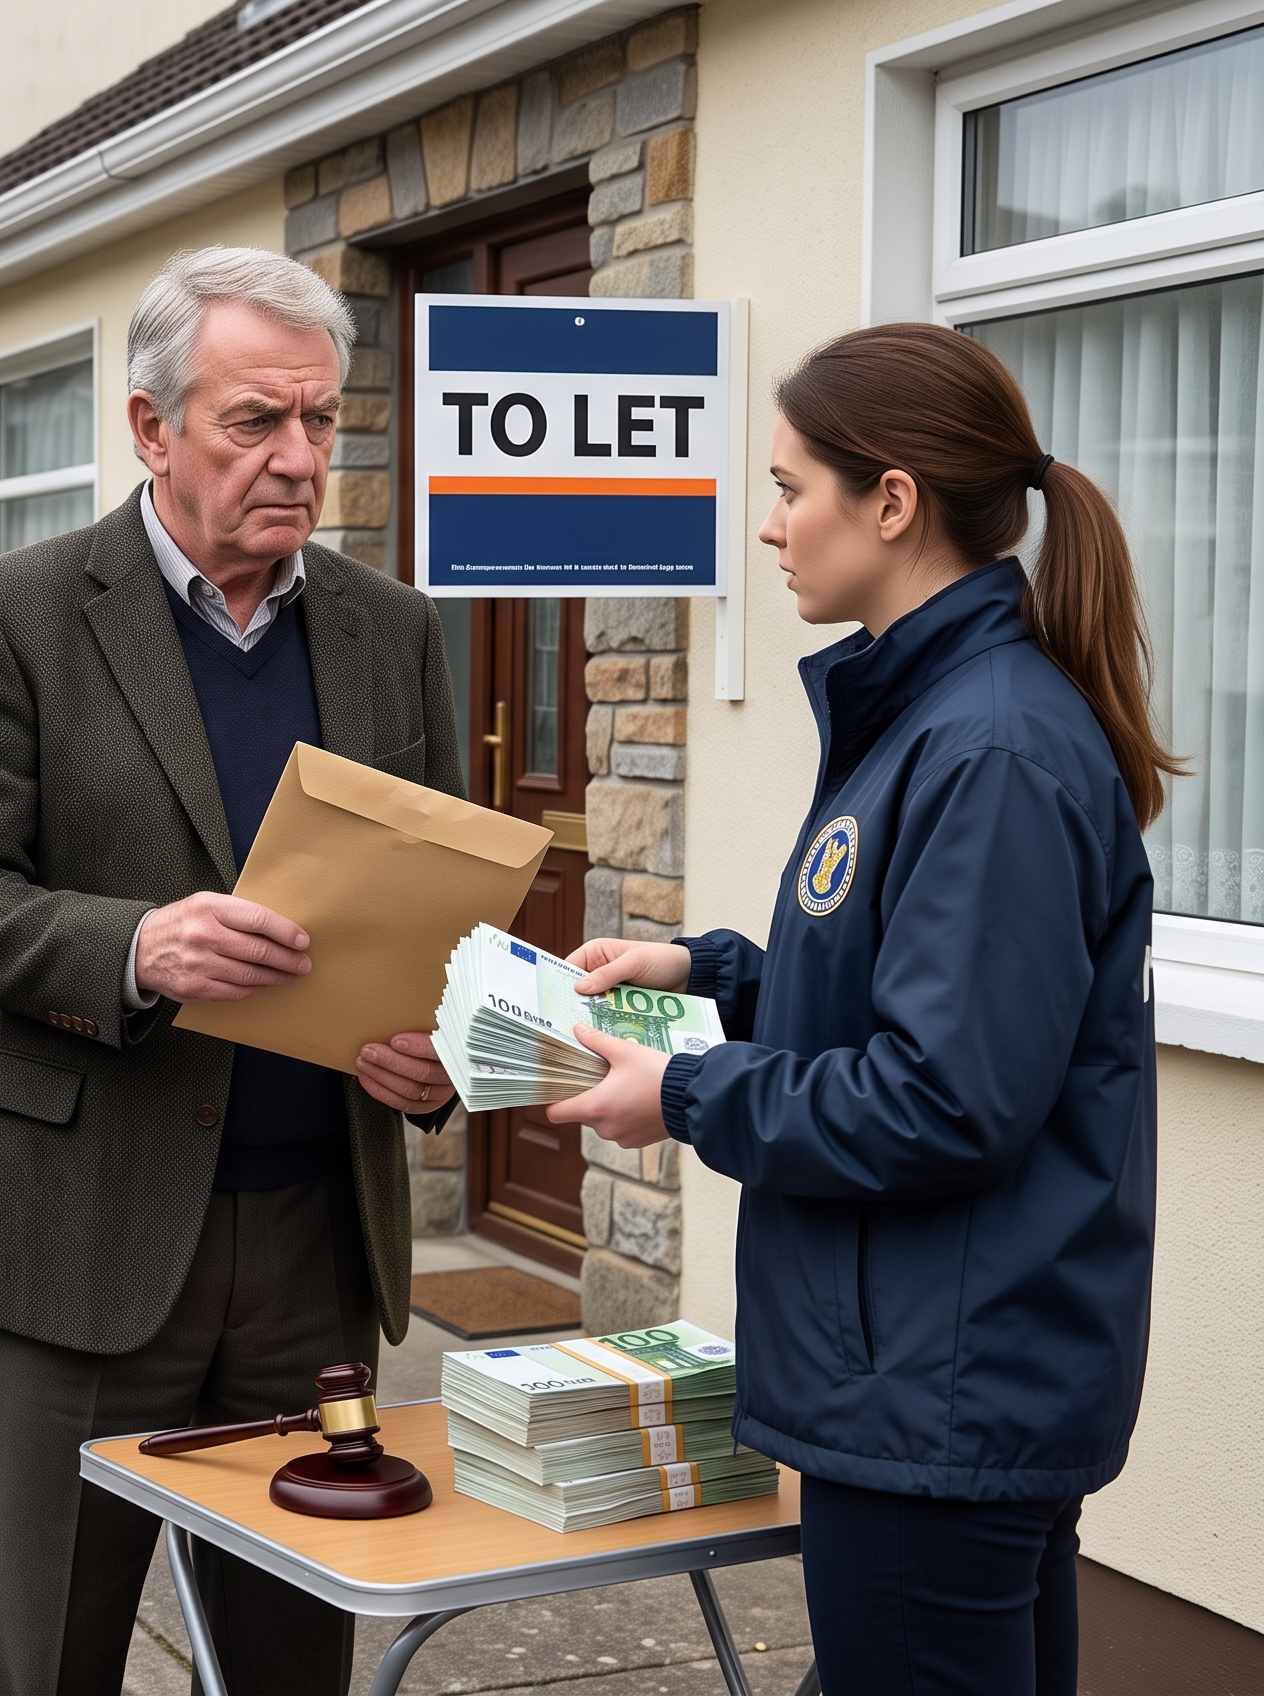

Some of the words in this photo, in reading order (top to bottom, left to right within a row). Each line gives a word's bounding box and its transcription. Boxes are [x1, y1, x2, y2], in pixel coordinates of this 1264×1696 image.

[442, 392, 548, 458] TO
[573, 394, 705, 458] LET
[488, 993, 522, 1017] 100
[614, 987, 685, 1020] 100
[598, 1329, 680, 1350] 100
